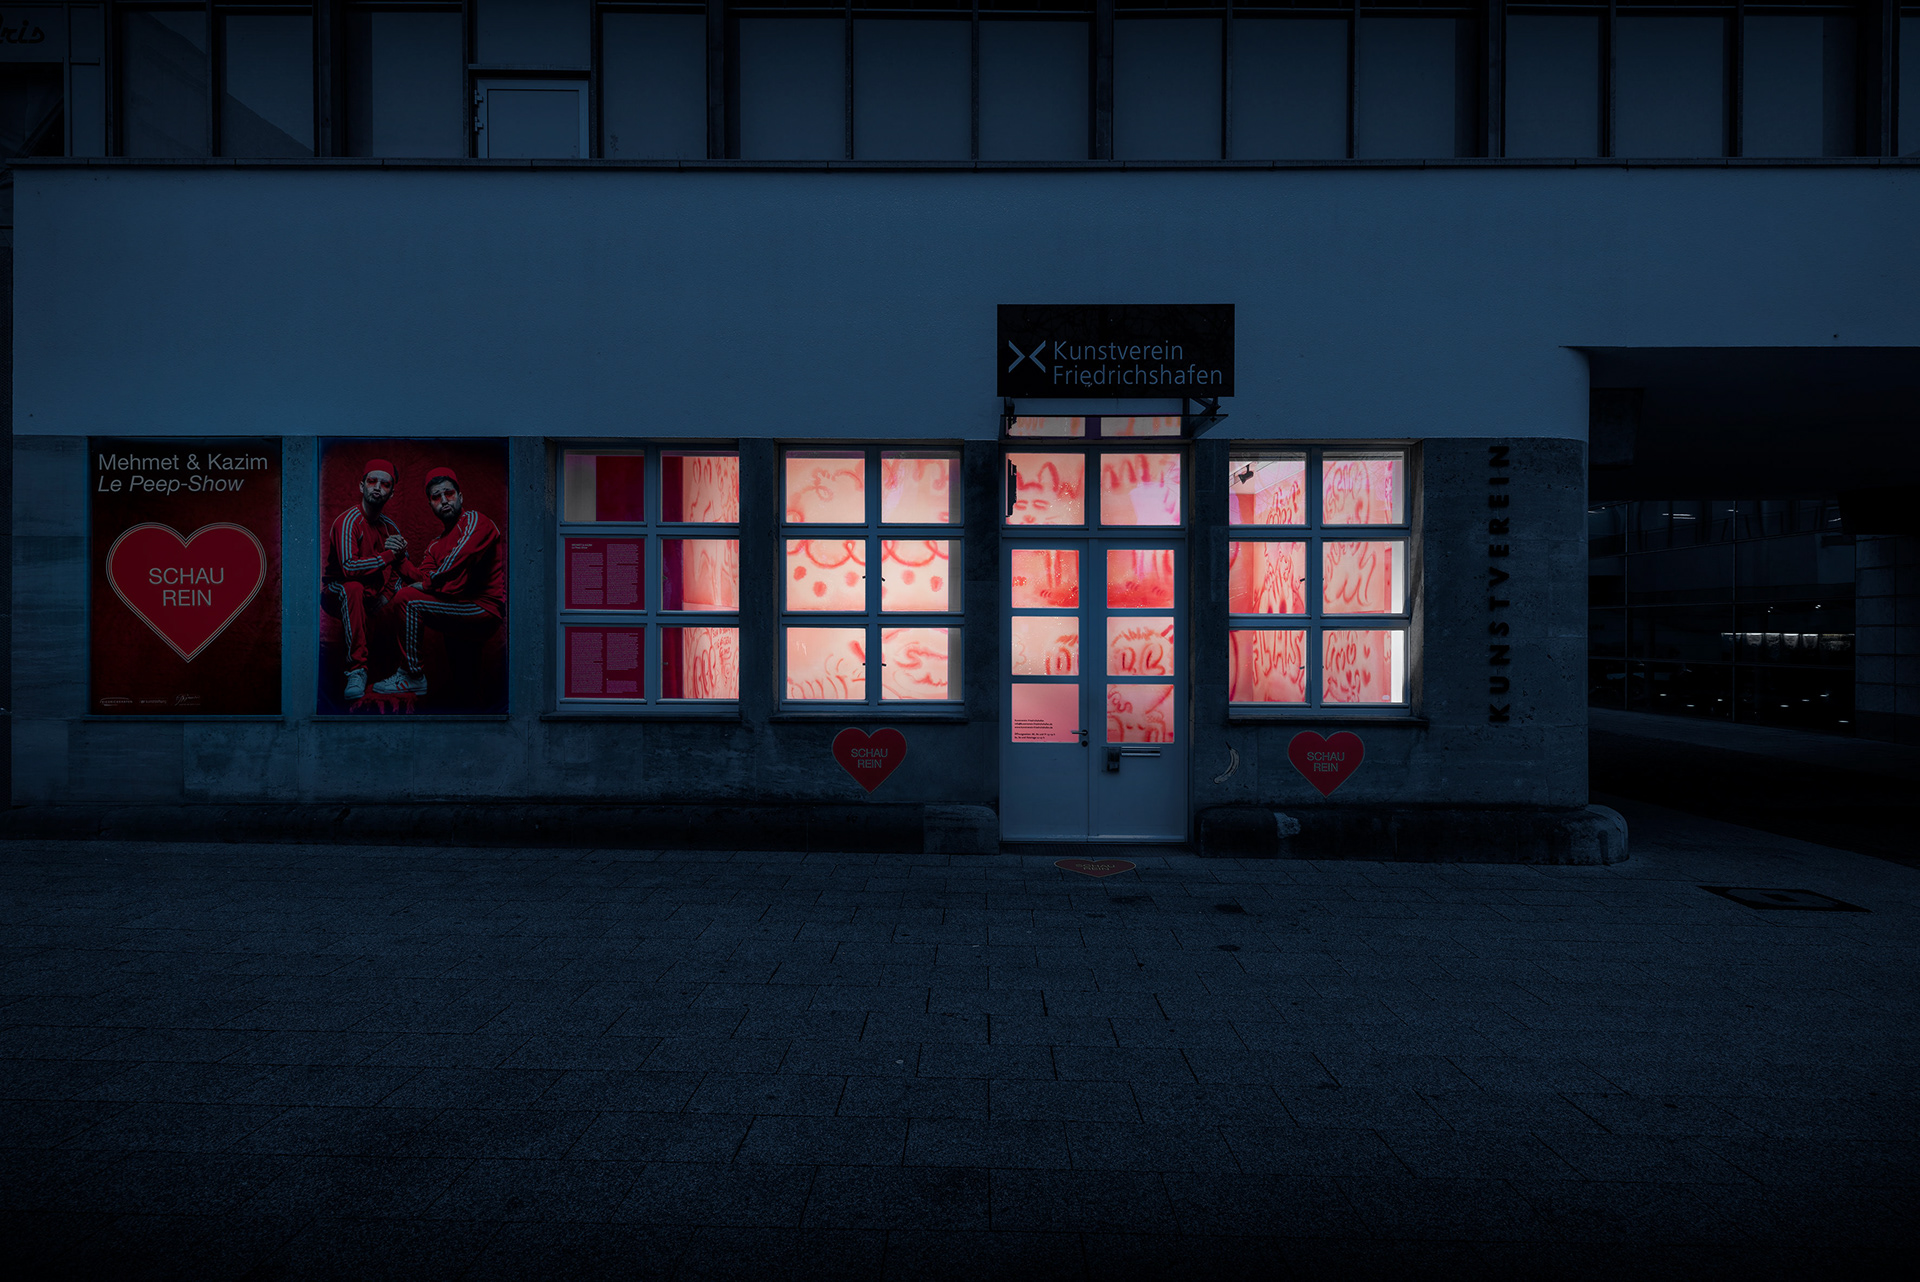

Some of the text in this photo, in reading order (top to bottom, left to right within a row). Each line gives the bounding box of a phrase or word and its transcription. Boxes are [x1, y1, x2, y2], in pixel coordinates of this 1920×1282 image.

[0, 14, 45, 43] ris
[1053, 340, 1184, 361] Kunstverein
[1053, 364, 1223, 386] Friedrichshafen
[98, 454, 268, 471] Mehmet & Kazim
[98, 475, 245, 496] Le Peep-Show
[148, 567, 225, 585] SCHAU
[1489, 446, 1510, 722] KUNSTVEREIN
[162, 589, 212, 607] REIN
[850, 748, 888, 758] SCHAU
[1306, 751, 1345, 761] SCHAU
[857, 759, 882, 768] REIN
[1313, 762, 1338, 772] REIN
